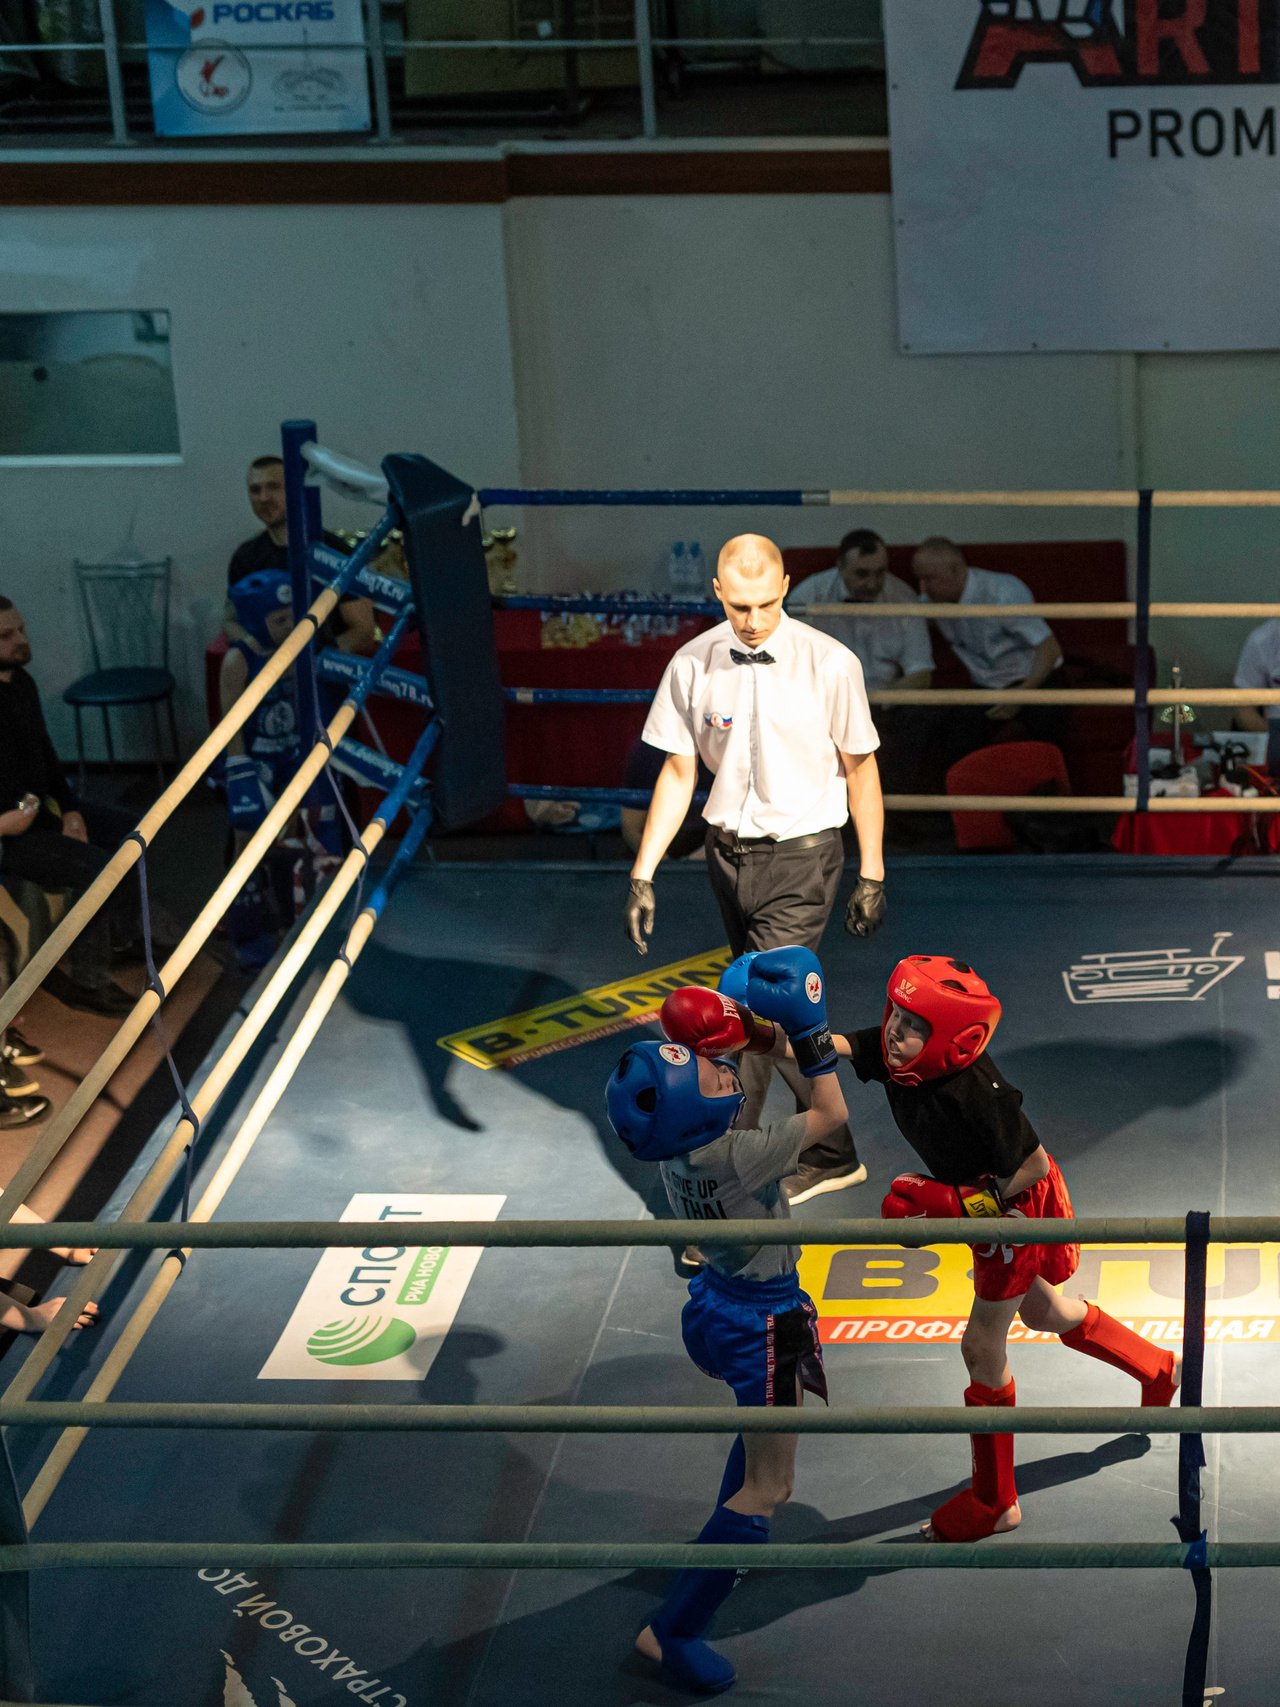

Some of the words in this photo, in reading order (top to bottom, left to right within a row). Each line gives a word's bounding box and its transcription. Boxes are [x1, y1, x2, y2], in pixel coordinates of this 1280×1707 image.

[211, 1, 335, 24] РОСКАБ
[697, 1179, 719, 1199] UP
[340, 1205, 423, 1307] СПОТ
[404, 1274, 428, 1302] РИА
